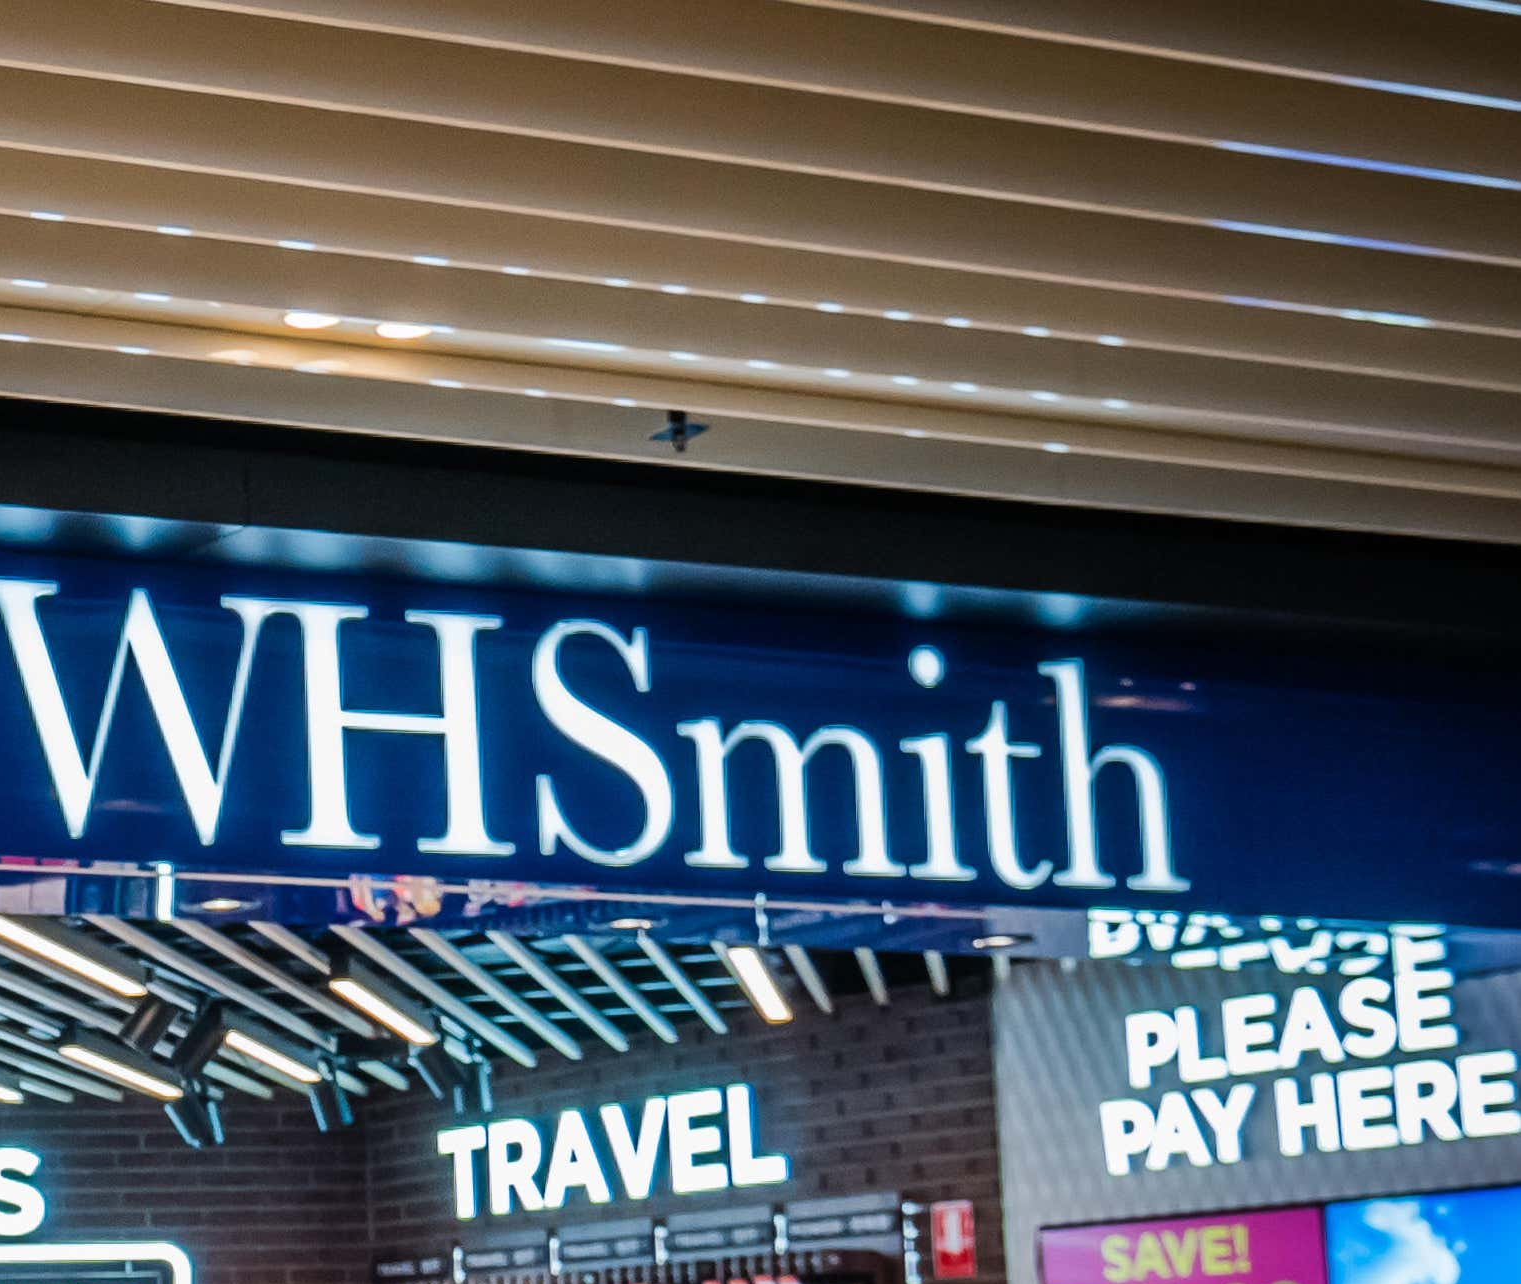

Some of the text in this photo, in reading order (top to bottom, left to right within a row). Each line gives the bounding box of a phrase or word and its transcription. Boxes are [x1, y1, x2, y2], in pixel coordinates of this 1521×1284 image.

[1125, 968, 1459, 1090] PLEASE
[437, 1083, 789, 1221] TRAVEL
[1099, 1050, 1521, 1176] PAY HERE
[1101, 1224, 1251, 1283] SAVE!
